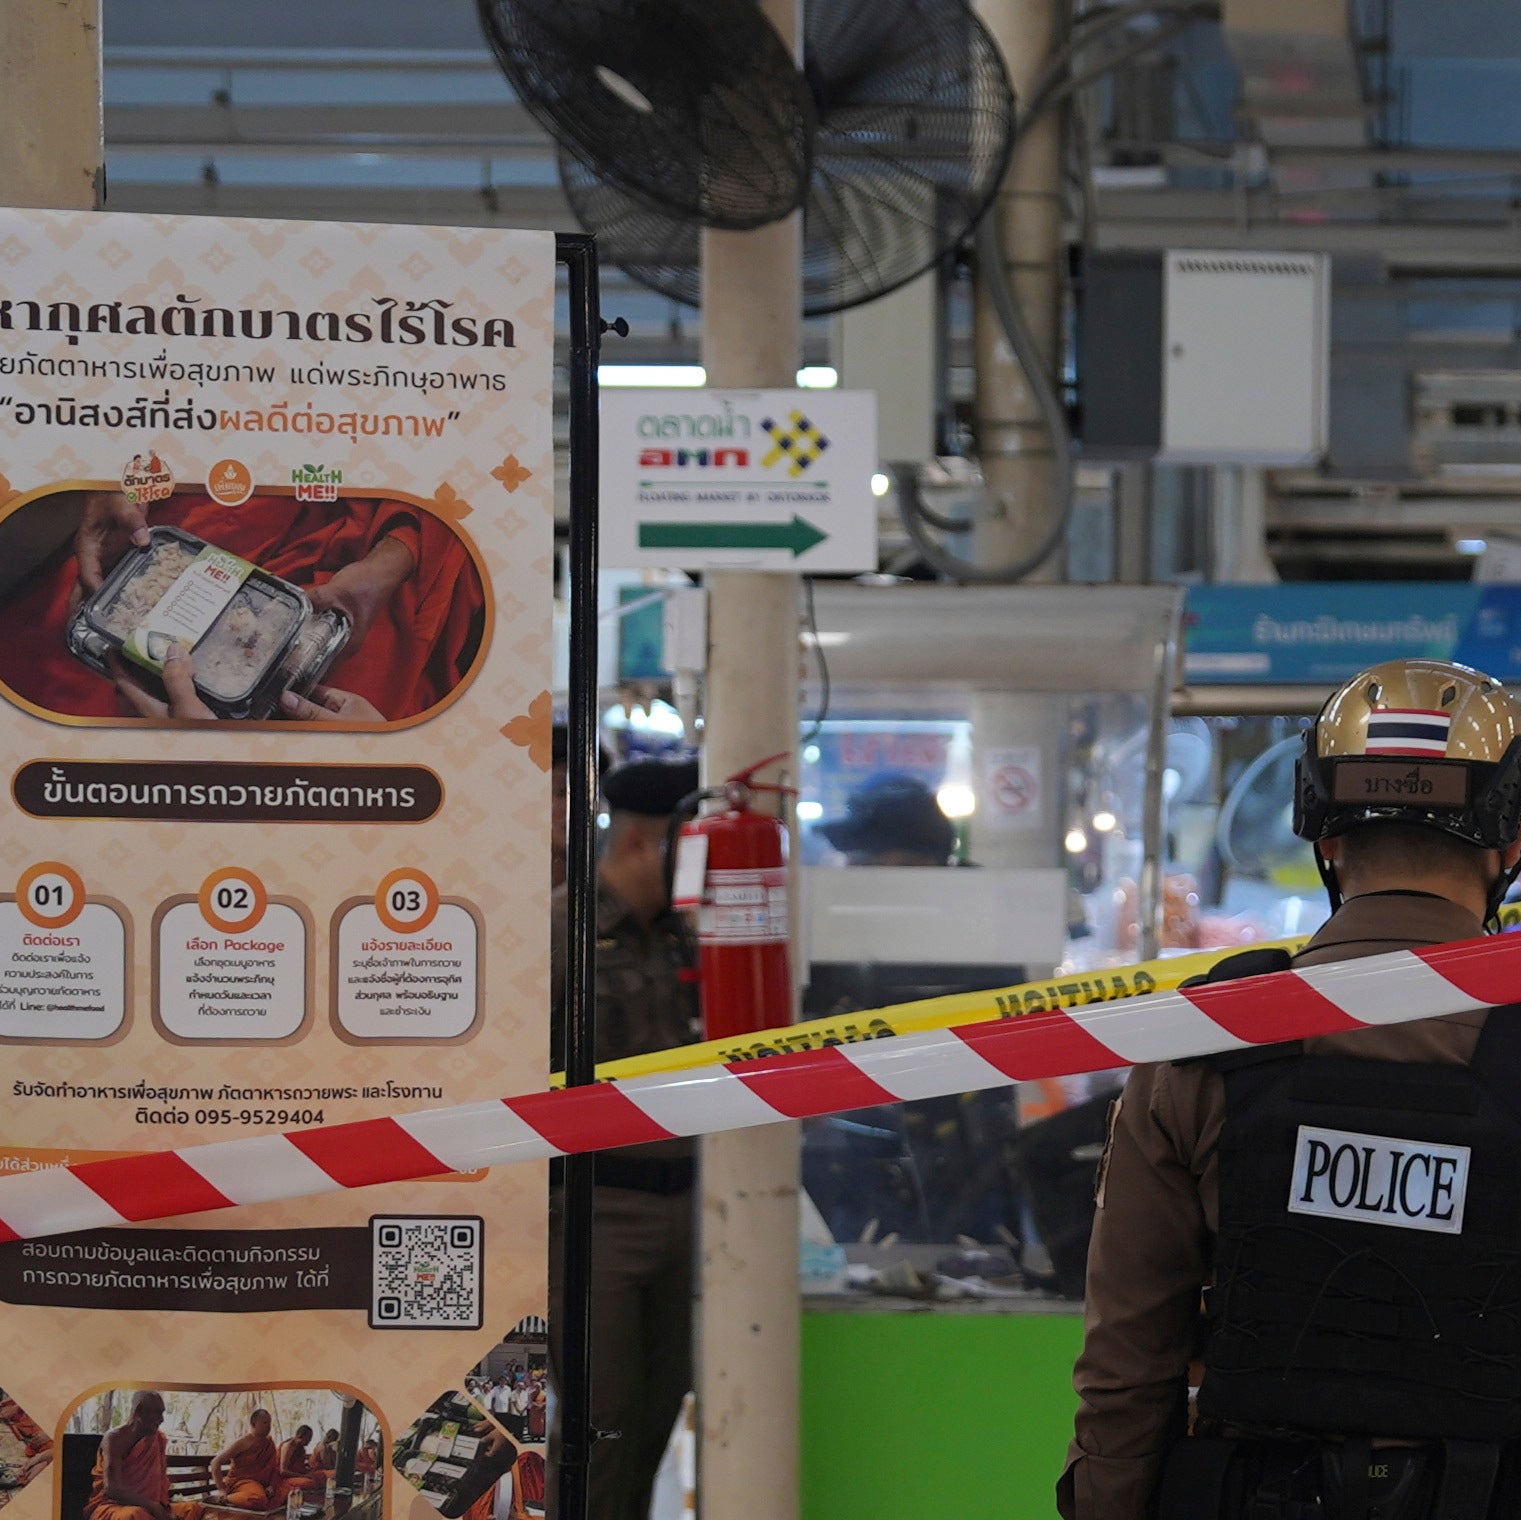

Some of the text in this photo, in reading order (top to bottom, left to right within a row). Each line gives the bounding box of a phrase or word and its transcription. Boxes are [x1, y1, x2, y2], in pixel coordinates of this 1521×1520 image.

[288, 358, 507, 397] แด่พระภิกษุอาพาธ
[292, 469, 342, 485] HEALTH
[298, 485, 337, 500] ME!!
[43, 766, 416, 812] ขั้นตอนการถวายภัตตาหาร
[1365, 767, 1433, 794] บางซื่อ
[34, 885, 65, 907] 01
[216, 887, 249, 911] 02
[391, 889, 422, 913] 03
[22, 933, 81, 947] ติดต่อเรา
[186, 937, 285, 953] เลือก Package
[361, 938, 453, 952] แจ้งรายละเอียด
[12, 1079, 443, 1106] รับจัดทำอาหารเพื่อสุขภาพ ภัตตาหารถวายพระ และโรงทาน
[135, 1105, 325, 1126] ติดต่อ 095-9529404
[1299, 1139, 1458, 1221] POLICE
[21, 1240, 321, 1265] สอบถามข้อมูลและติดตามกิจกรรม
[22, 1266, 330, 1295] การถวายภัตตาหารเพื่อสุขภาพ ได้ที่
